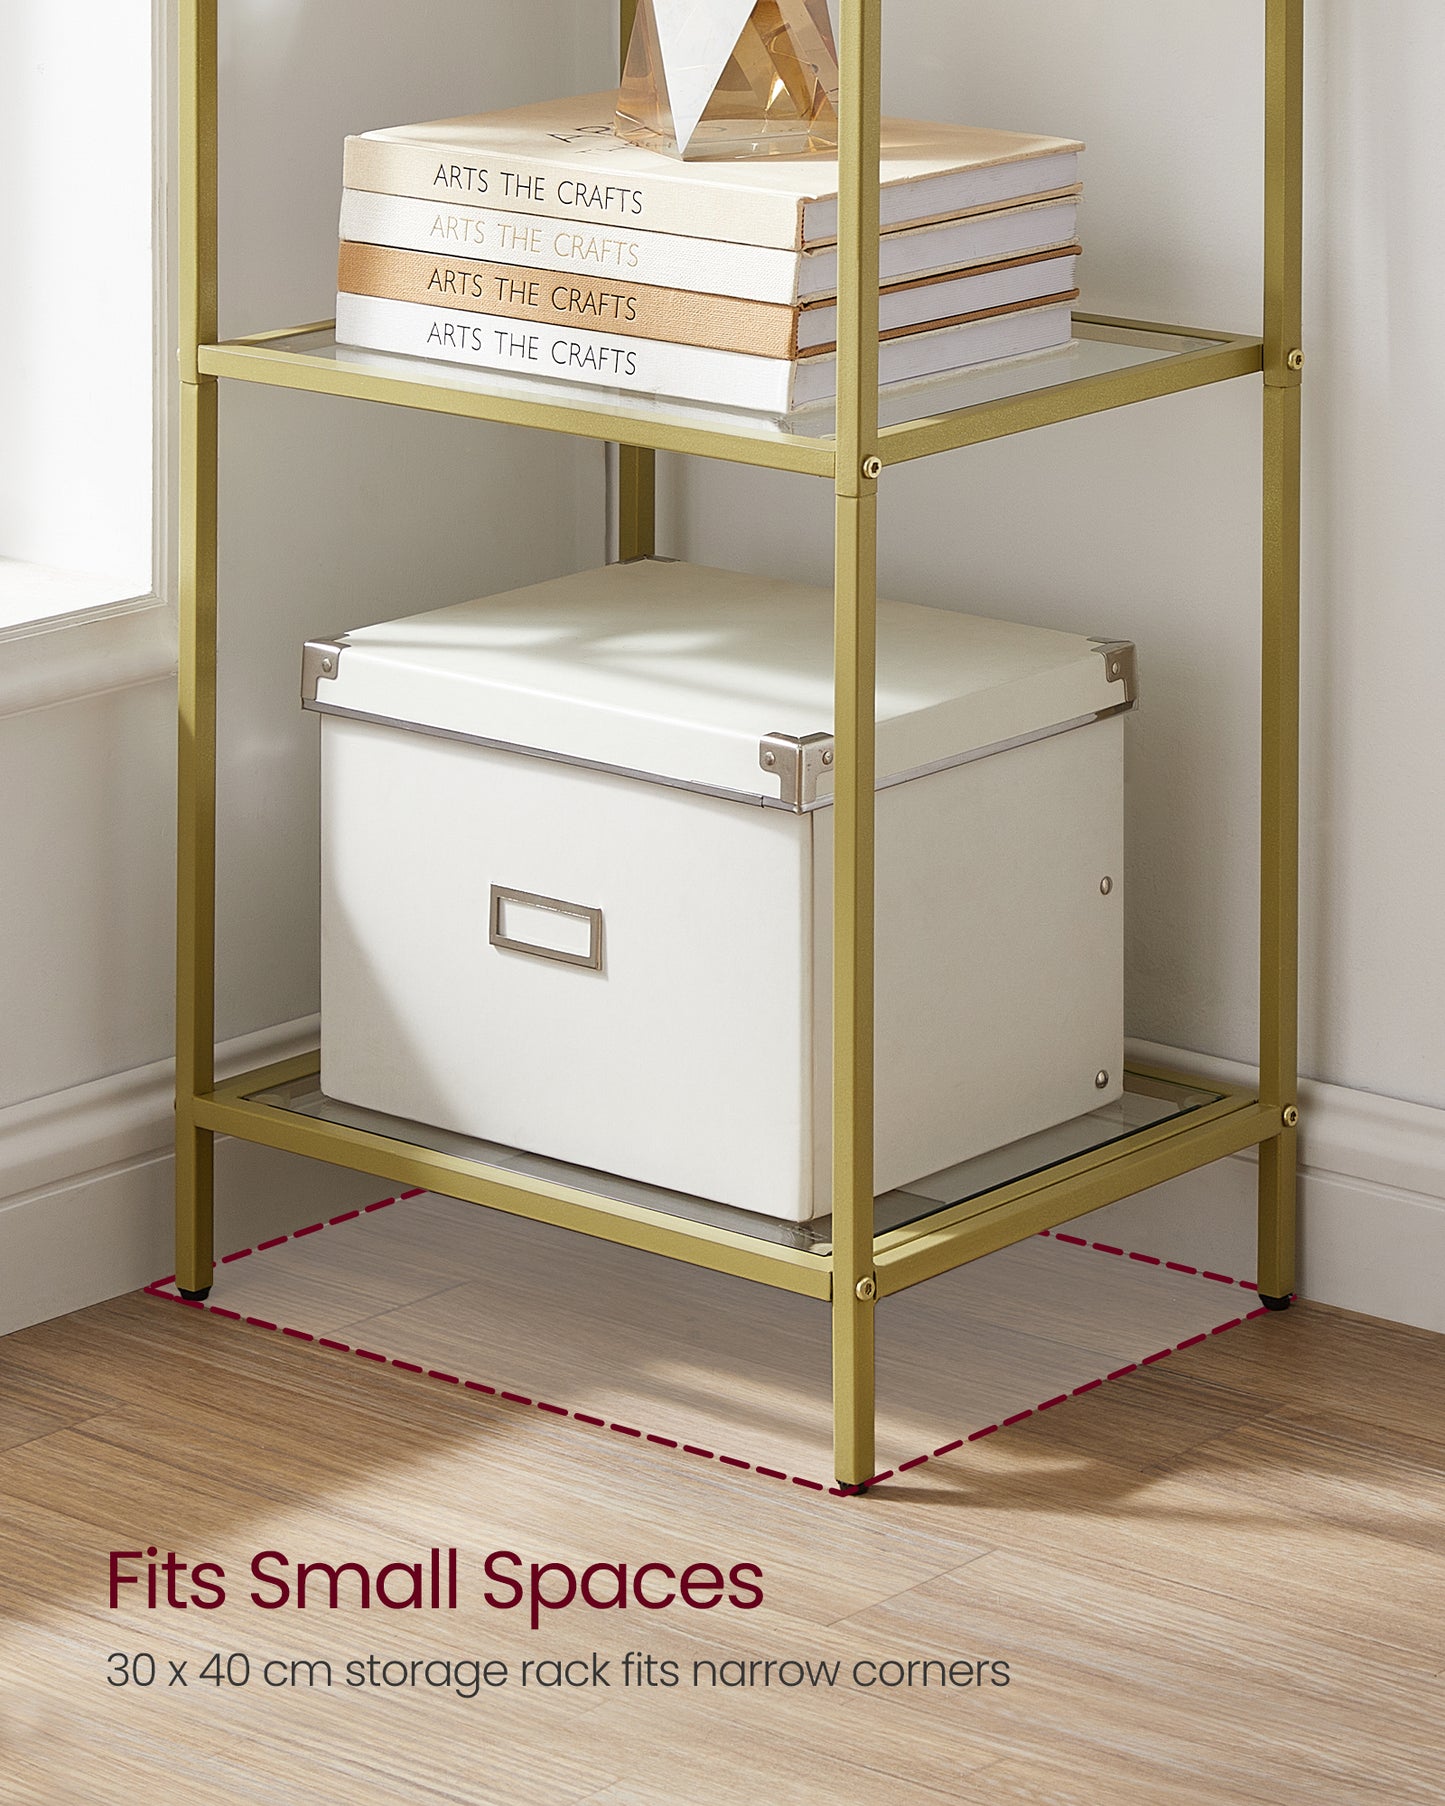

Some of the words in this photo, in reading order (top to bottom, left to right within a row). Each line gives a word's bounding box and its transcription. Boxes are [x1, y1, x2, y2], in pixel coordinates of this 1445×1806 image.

[433, 164, 488, 192] ARTS
[500, 172, 545, 201] THE
[557, 180, 643, 215] CRAFTS
[429, 214, 486, 244] ARTS
[497, 223, 543, 253] THE
[554, 232, 639, 267] CRAFTS
[427, 268, 483, 298] ARTS
[494, 277, 540, 307] THE
[551, 286, 638, 321] CRAFTS
[426, 321, 482, 351] ARTS
[494, 330, 539, 360] THE
[551, 340, 637, 376] CRAFTS
